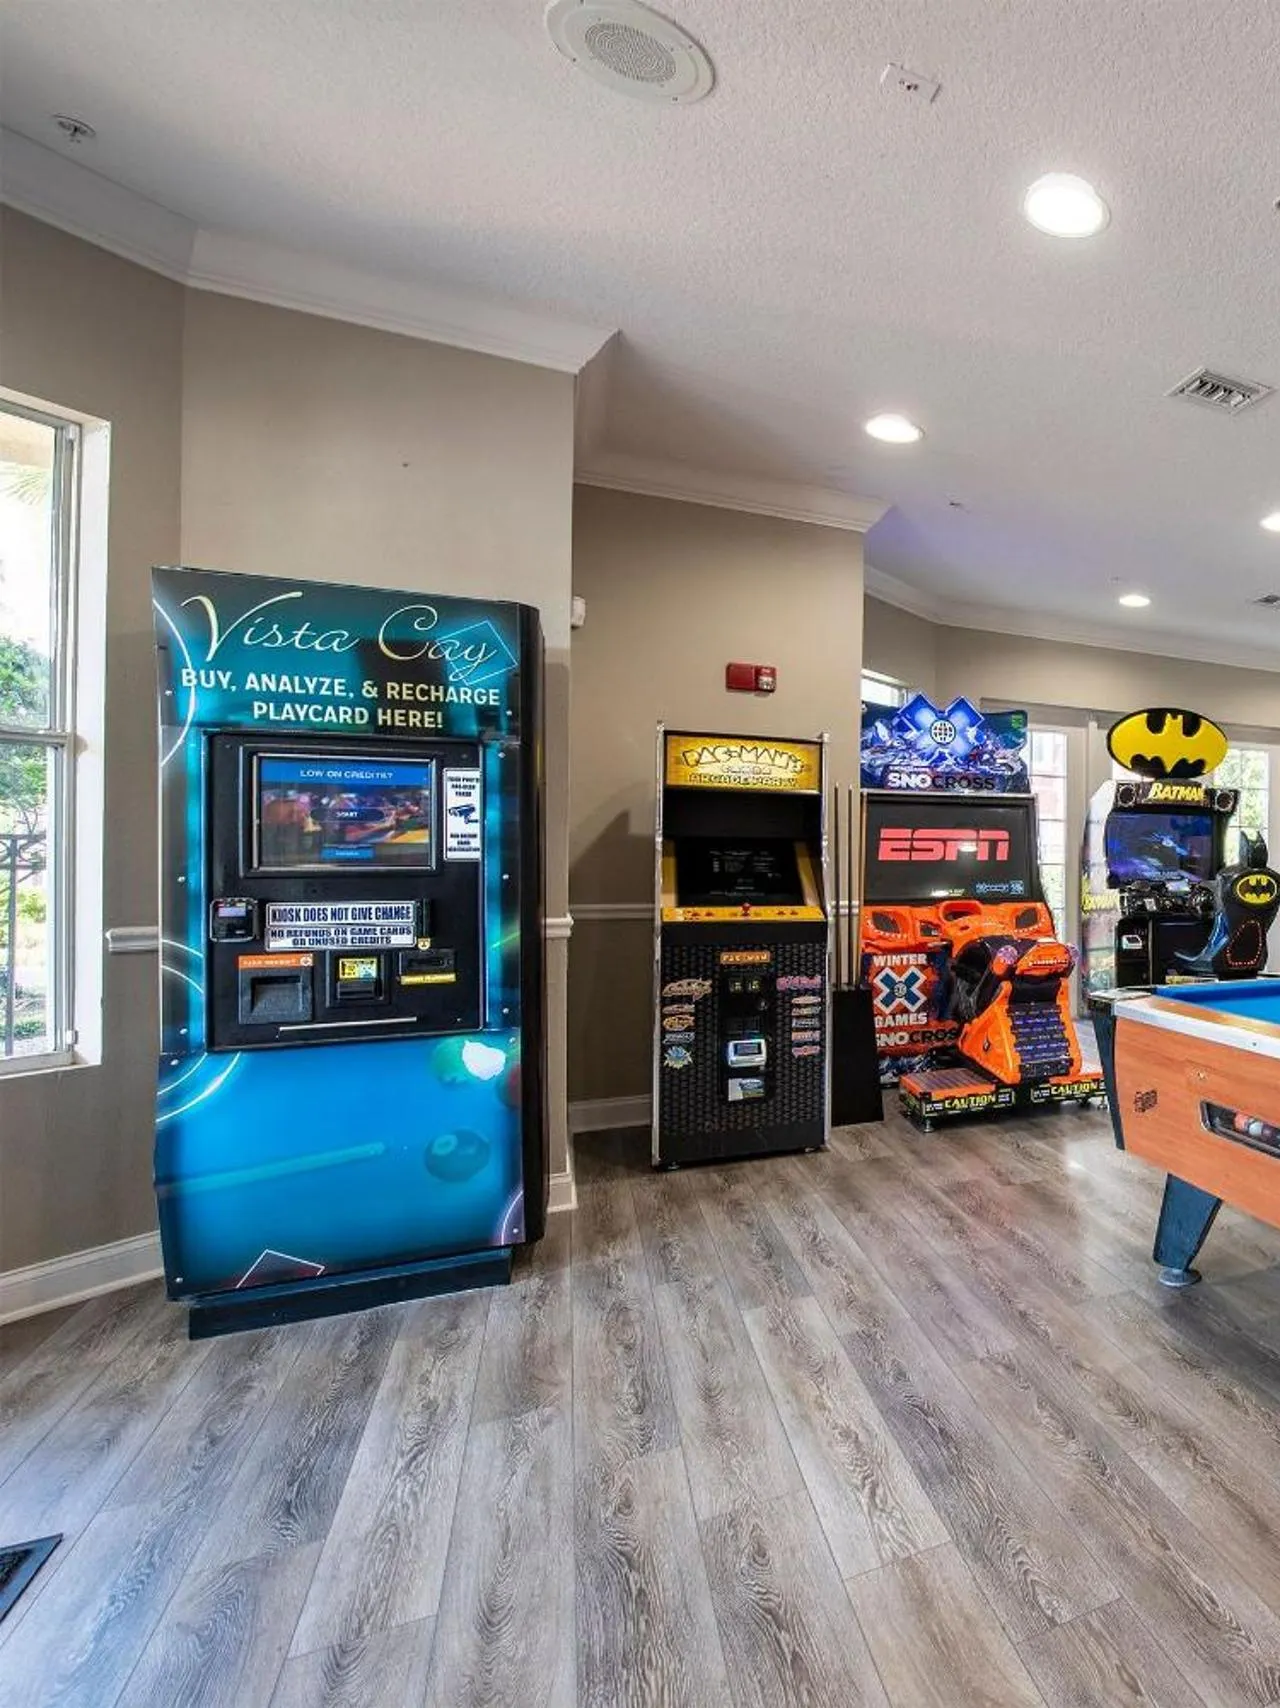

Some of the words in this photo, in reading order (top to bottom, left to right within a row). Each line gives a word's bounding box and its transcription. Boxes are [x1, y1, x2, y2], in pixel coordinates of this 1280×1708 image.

[181, 592, 359, 662] Vista
[379, 605, 497, 681] Cay
[182, 669, 236, 692] BUY,
[245, 673, 353, 699] ANALYZE,
[362, 680, 378, 698] &
[387, 681, 500, 706] RECHARGE
[253, 704, 369, 726] PLAYCARD
[377, 709, 443, 729] HERE!
[887, 772, 996, 791] SNOCROSS
[1149, 782, 1206, 801] BATMAN
[878, 828, 1010, 861] ESPN
[271, 907, 301, 923] KIOSK
[304, 907, 328, 922] DOES
[331, 907, 349, 922] NOT
[352, 906, 373, 921] GIVE
[375, 905, 411, 920] CHANGE
[271, 929, 284, 938] NO
[334, 928, 347, 937] ON
[873, 953, 927, 966] WINTER
[874, 1012, 928, 1028] GAMES
[1051, 1081, 1098, 1095] CAUTION
[945, 1094, 996, 1109] CAUTION
